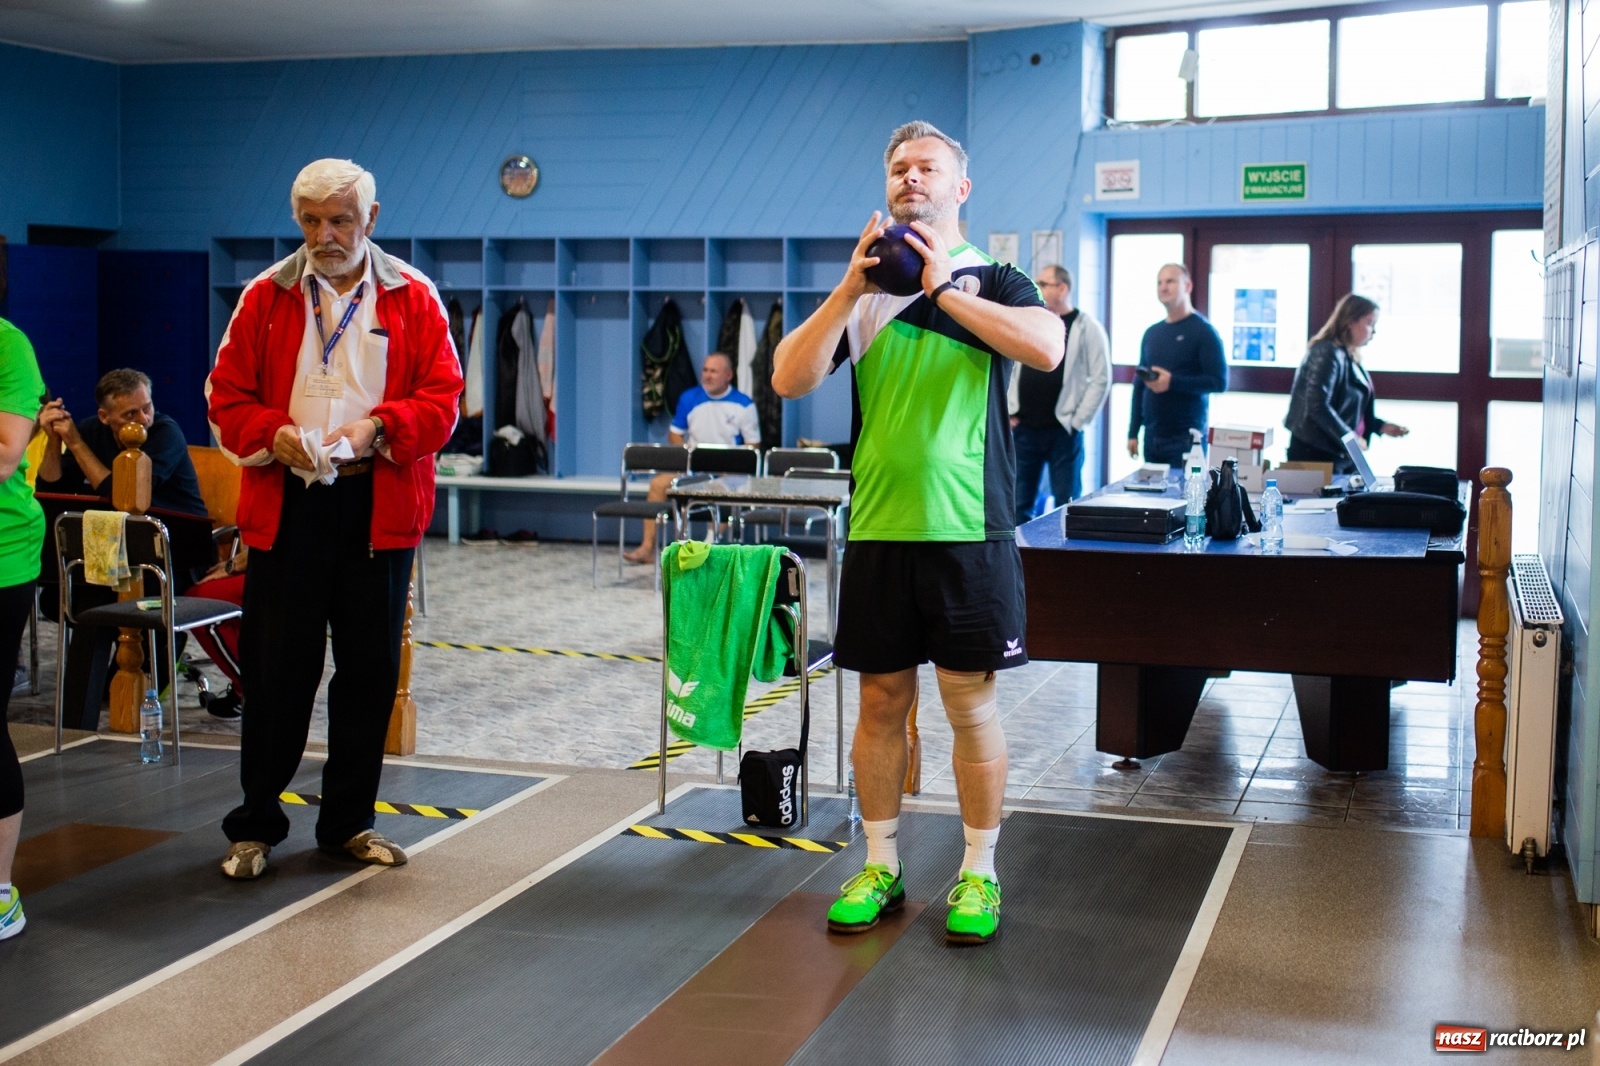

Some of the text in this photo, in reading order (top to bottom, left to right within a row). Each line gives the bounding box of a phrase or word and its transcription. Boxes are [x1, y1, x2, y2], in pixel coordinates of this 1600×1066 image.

[1003, 647, 1023, 658] erima
[666, 699, 697, 729] ima
[779, 764, 794, 825] adidas
